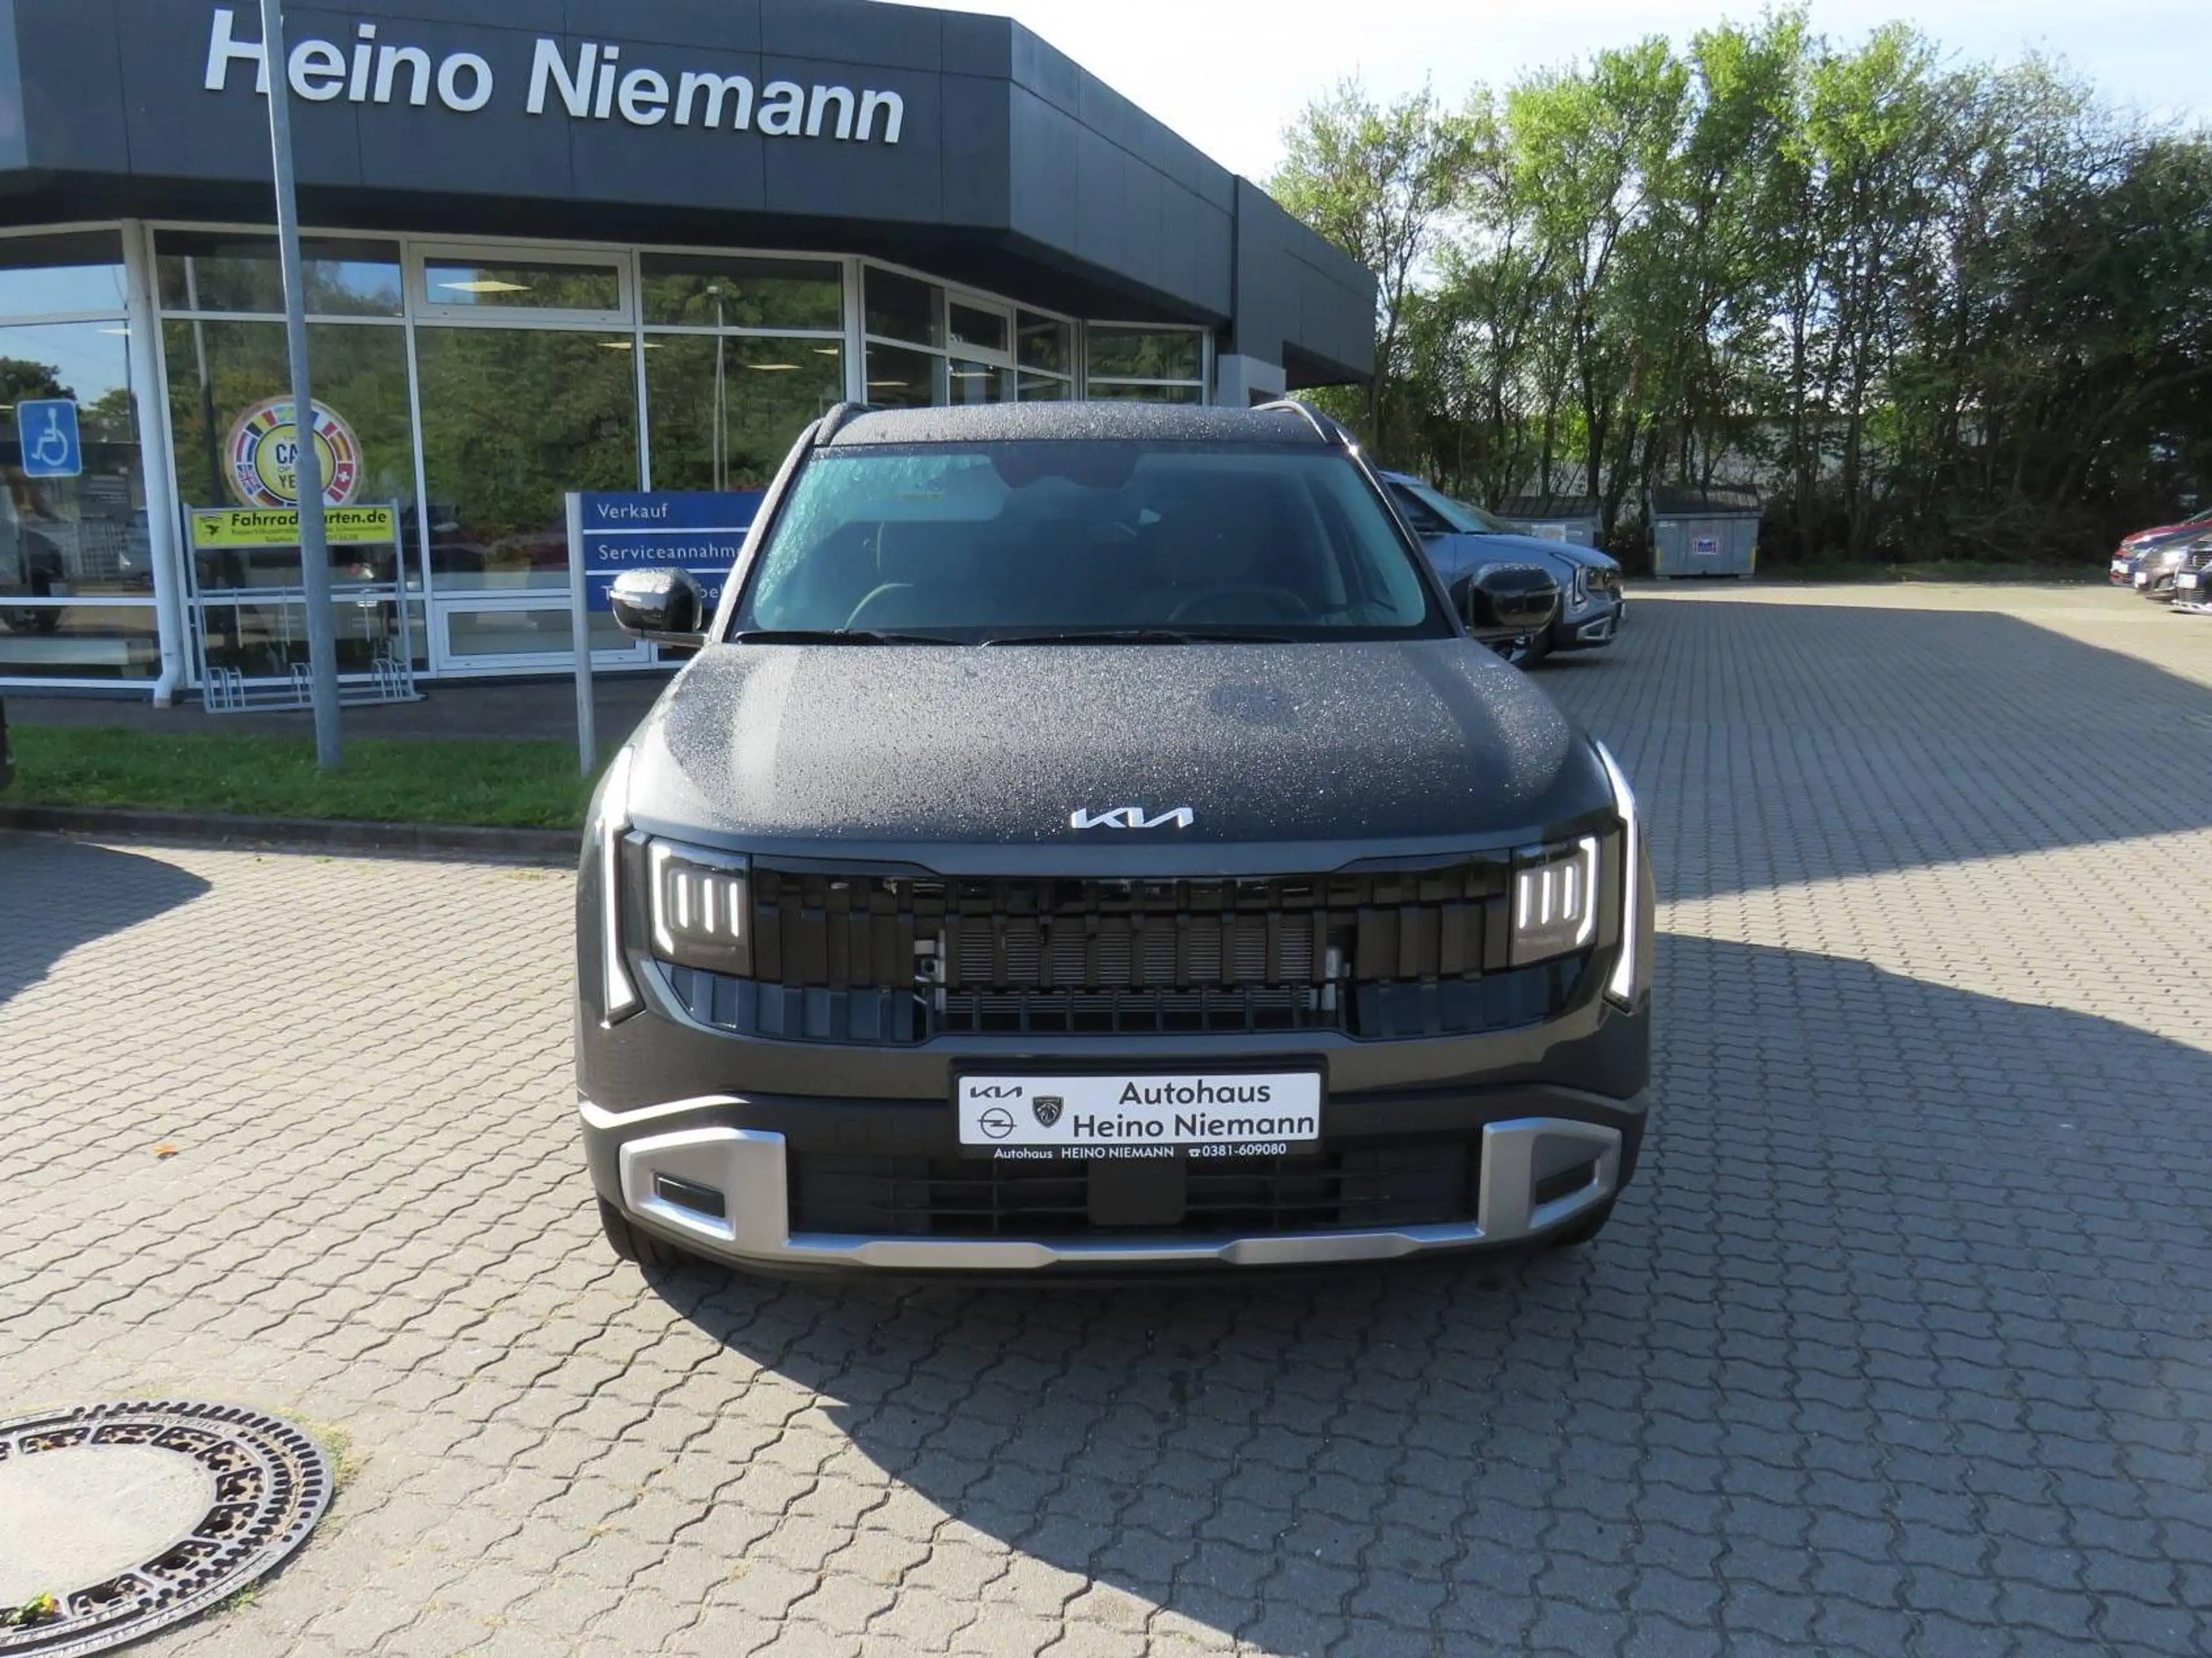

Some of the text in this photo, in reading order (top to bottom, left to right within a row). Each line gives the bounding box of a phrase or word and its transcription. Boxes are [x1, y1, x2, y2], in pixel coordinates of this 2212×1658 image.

[204, 9, 904, 143] Heino Niemann
[275, 444, 298, 464] CA
[597, 502, 668, 518] Verkauf
[598, 543, 741, 560] Serviceannahm
[1071, 807, 1194, 828] KIA
[970, 1085, 1023, 1099] KIA
[1119, 1079, 1271, 1105] Autohaus
[1073, 1112, 1315, 1138] Heino Niemann
[994, 1143, 1287, 1159] Autohaus HEINO NIEMANN 0381-609080
